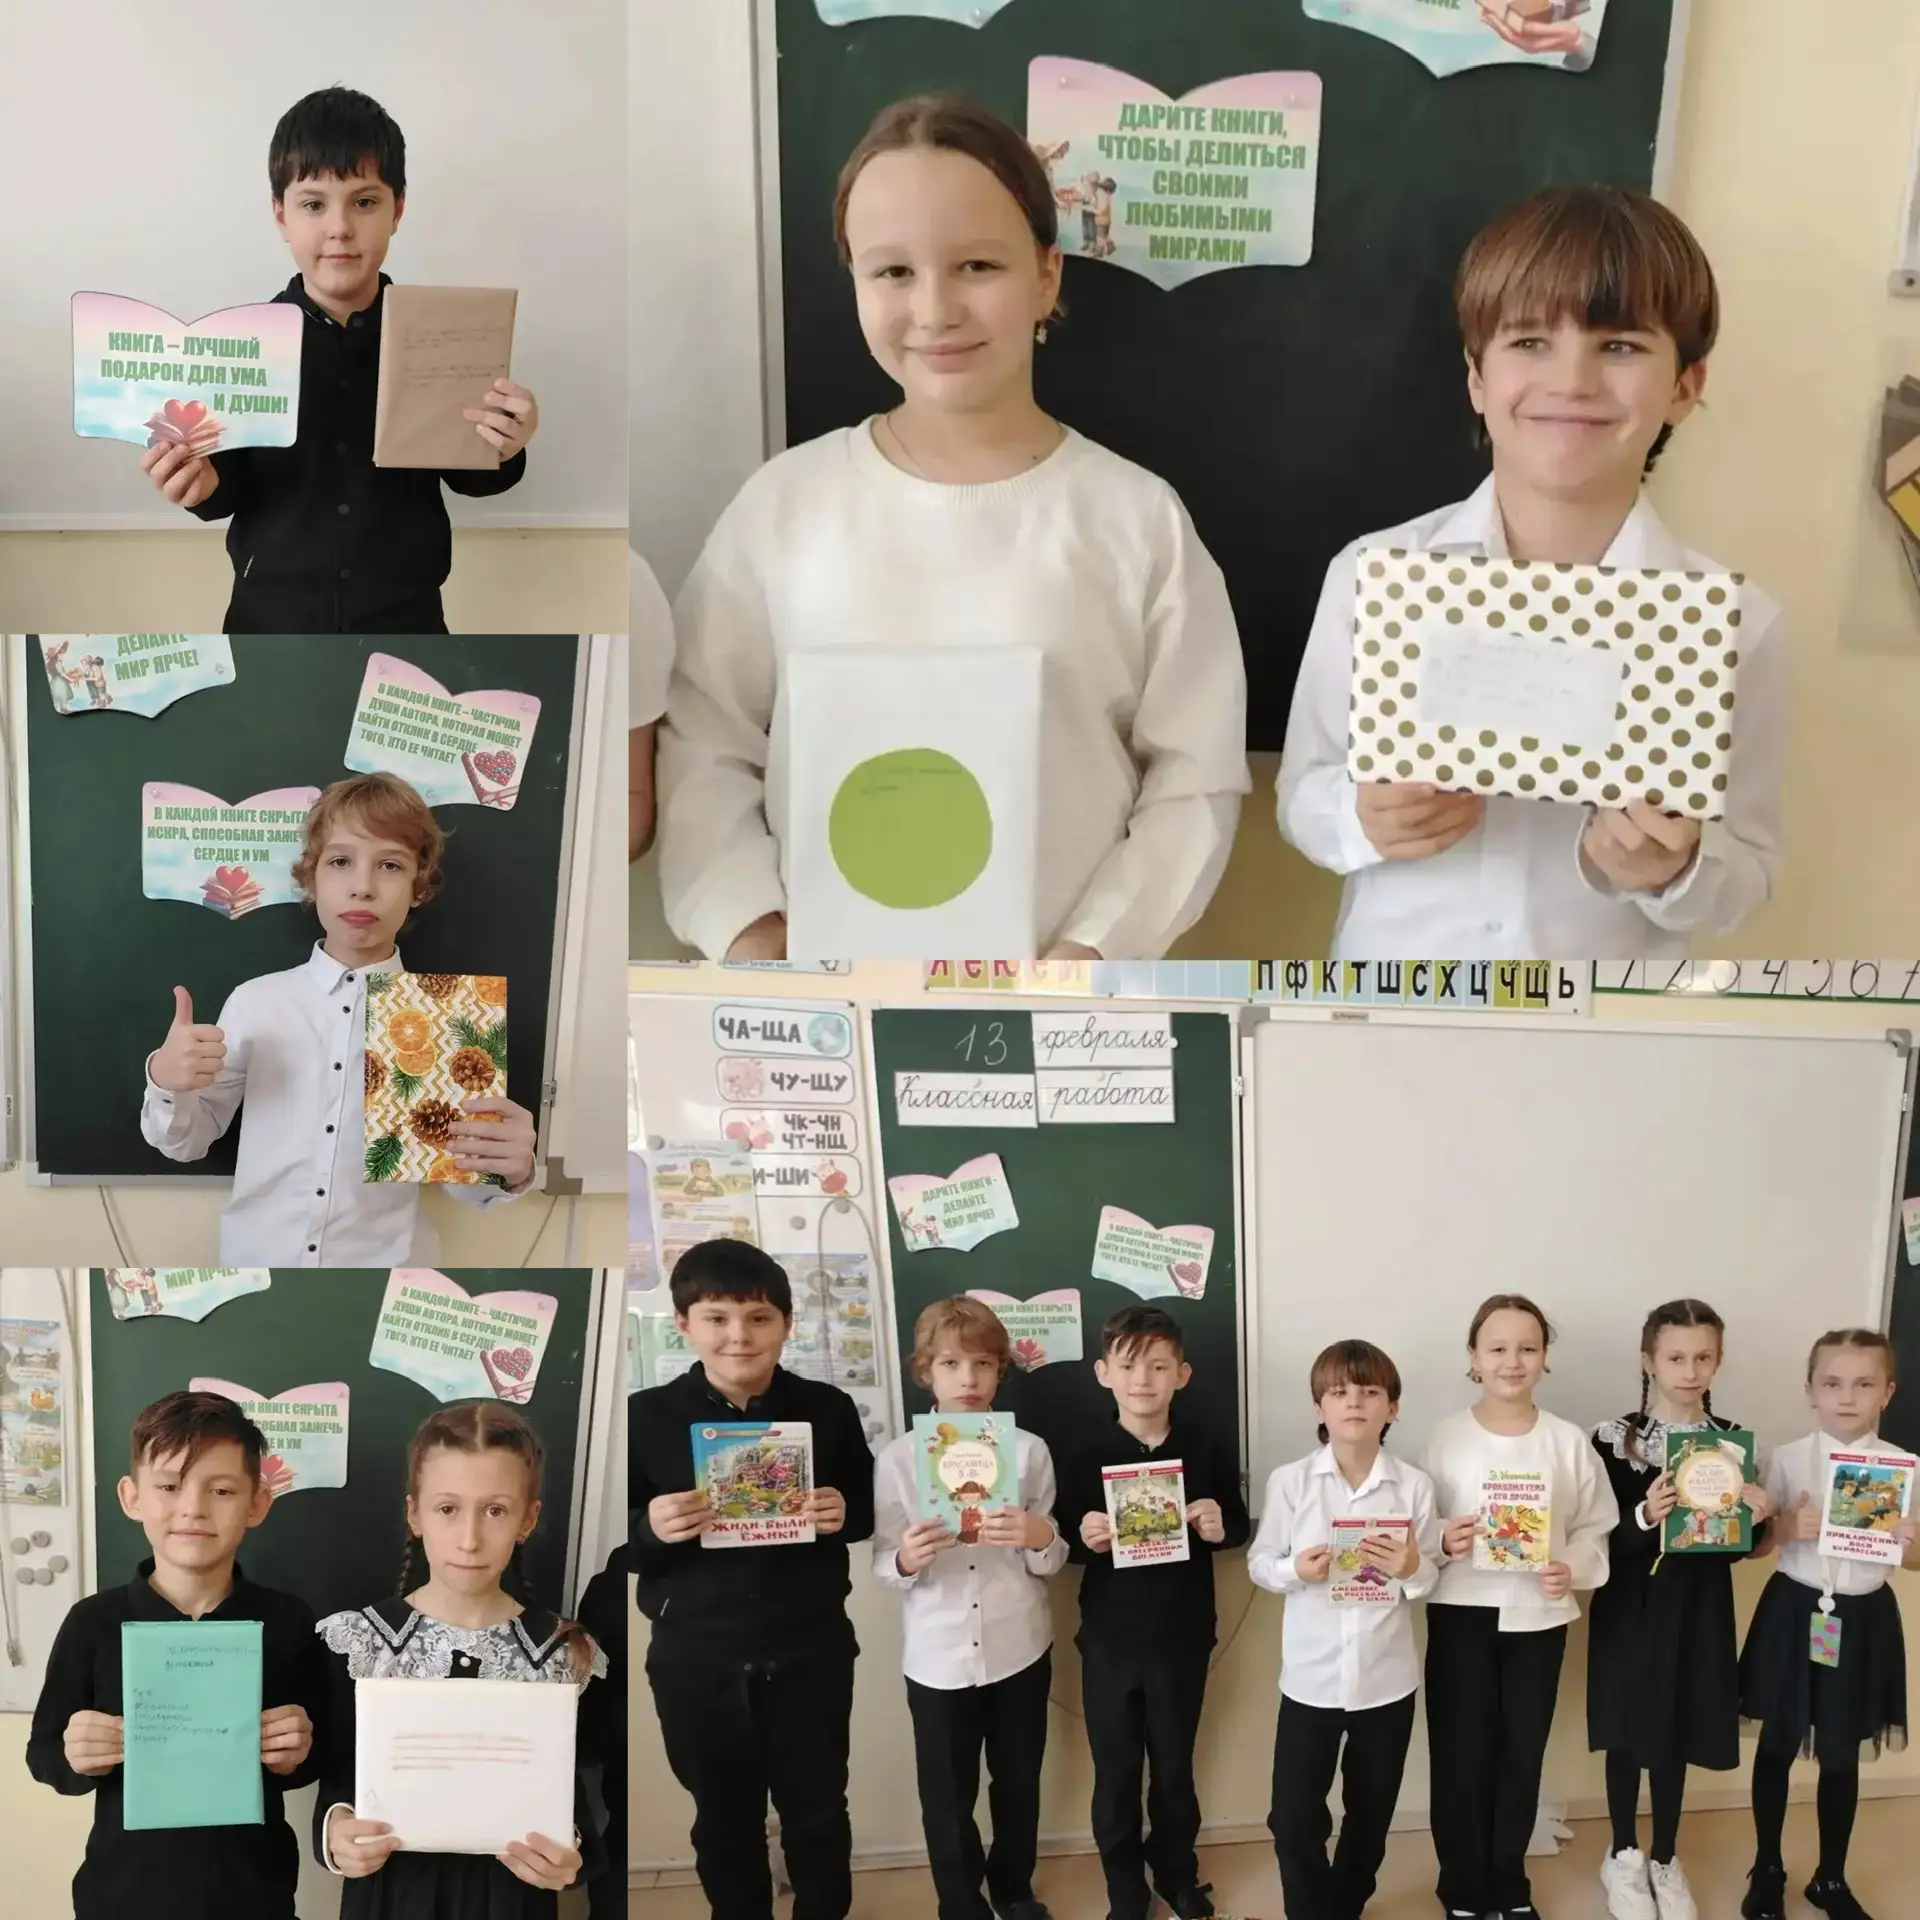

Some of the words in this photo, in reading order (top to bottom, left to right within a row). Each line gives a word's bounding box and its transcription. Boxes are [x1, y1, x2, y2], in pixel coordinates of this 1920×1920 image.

[1118, 102, 1206, 131] ДАРИТЕ
[1210, 107, 1288, 139] КНИГИ,
[1097, 134, 1181, 163] ЧТОБЫ
[1185, 139, 1307, 169] ДЕЛИТЬСЯ
[1152, 169, 1250, 200] СВОИМИ
[1125, 201, 1273, 233] ЛЮБИМЫМИ
[1149, 234, 1247, 264] МИРАМИ
[108, 332, 165, 354] КНИГА
[182, 336, 260, 360] ЛУЧШИЙ
[101, 359, 184, 382] ПОДАРОК
[187, 364, 227, 387] ДЛЯ
[230, 367, 267, 388] УМА
[213, 393, 225, 412] И
[229, 394, 289, 415] ДУШИ!
[114, 658, 150, 681] МИР
[153, 648, 200, 675] ЯРЧЕ!
[377, 682, 387, 694] В
[386, 684, 431, 708] КАЖДОЙ
[430, 696, 463, 717] КНИГЕ
[470, 708, 522, 732] ЧАСТИЧКА
[357, 711, 391, 730] НАЙТИ
[390, 718, 431, 741] ОТКЛИК
[430, 731, 440, 744] В
[440, 733, 479, 754] СЕРДЦЕ
[368, 697, 402, 718] ДУШИ
[400, 705, 440, 728] АВТОРА,
[441, 715, 487, 739] КОТОРАЯ
[486, 728, 523, 750] МОЖЕТ
[360, 728, 387, 748] ТОГО,
[386, 735, 407, 752] КТО
[407, 742, 420, 754] ЕЕ
[420, 744, 457, 765] ЧИТАЕТ
[154, 806, 163, 820] В
[165, 805, 218, 823] КАЖДОЙ
[219, 808, 257, 823] КНИГЕ
[147, 826, 190, 842] ИСКРА,
[192, 827, 265, 842] СПОСОБНАЯ
[266, 829, 303, 843] ЗАЖЕ
[193, 847, 240, 863] СЕРДЦЕ
[242, 848, 250, 861] И
[252, 849, 270, 862] УМ
[718, 1017, 802, 1043] ЧА-ЩА
[1038, 1016, 1170, 1062] февраля
[955, 1022, 1008, 1066] 13
[770, 1072, 848, 1092] ЧУ-ЩУ
[898, 1074, 1034, 1110] Классная
[1050, 1072, 1169, 1119] работа
[784, 1114, 842, 1131] ЧК-ЧН
[782, 1133, 848, 1150] ЧТ-НЩ
[754, 1167, 810, 1186] И-ШИ
[922, 1183, 959, 1203] ДАРИТЕ
[943, 1194, 987, 1215] ДЕЛАЙТЕ
[942, 1217, 965, 1229] МИР
[966, 1208, 996, 1224] ЯРЧЕ!
[164, 1269, 195, 1290] МИР
[400, 1286, 409, 1297] В
[409, 1287, 450, 1309] КАЖДОЙ
[450, 1298, 480, 1316] КНИГЕ
[489, 1308, 538, 1330] ЧАСТИЧКА
[382, 1313, 413, 1330] НАЙТИ
[413, 1320, 450, 1340] ОТКЛИК
[450, 1330, 459, 1341] В
[459, 1332, 496, 1352] СЕРДЦЕ
[392, 1300, 423, 1316] ДУШИ
[422, 1308, 460, 1327] АВТОРА,
[460, 1317, 505, 1337] КОТОРАЯ
[503, 1327, 539, 1346] МОЖЕТ
[385, 1329, 409, 1346] ТОГО,
[409, 1336, 428, 1350] КТО
[429, 1341, 439, 1352] ЕЕ
[441, 1343, 475, 1361] ЧИТАЕТ
[258, 1402, 292, 1414] КНИГЕ
[292, 1403, 338, 1417] СКРЫТА
[299, 1421, 343, 1434] ЗАЖЕЧЬ
[276, 1438, 284, 1449] И
[286, 1438, 302, 1449] УМ
[1482, 1483, 1524, 1491] КРОКОДИЛ
[711, 1519, 807, 1532] ЖИЛИ-БЫЛИ
[741, 1530, 799, 1542] ЁЖИКИ
